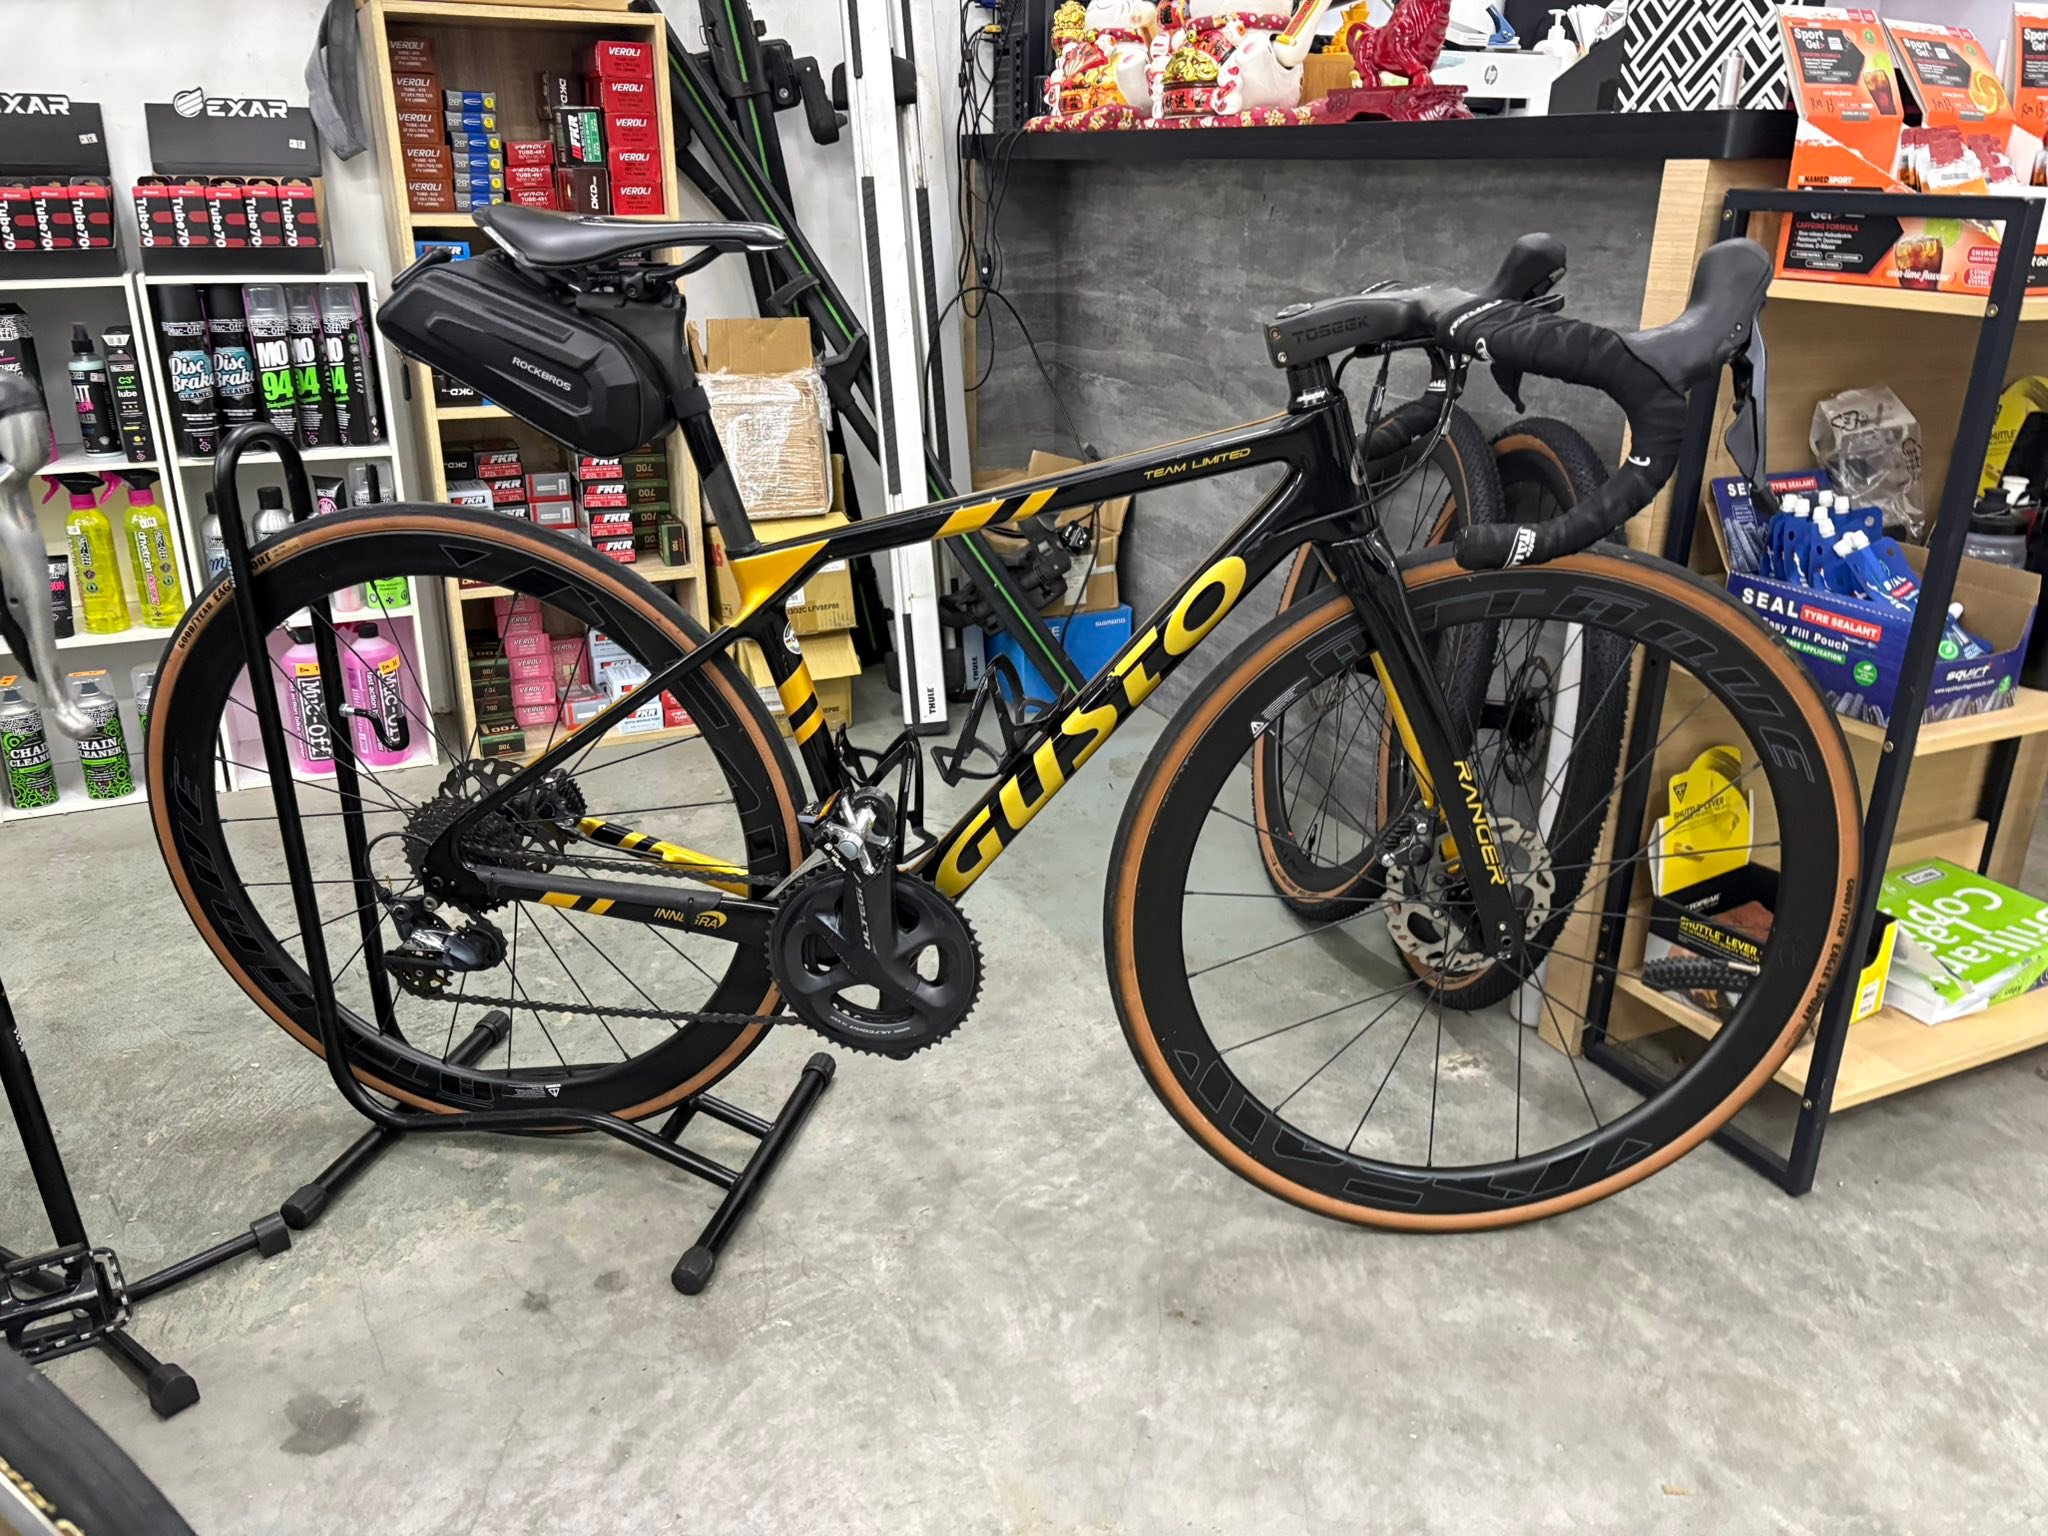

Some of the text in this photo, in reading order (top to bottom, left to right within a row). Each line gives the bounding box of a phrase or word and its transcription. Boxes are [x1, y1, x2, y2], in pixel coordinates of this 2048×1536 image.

[1794, 28, 1824, 40] Sport
[2024, 28, 2048, 43] Spor
[390, 41, 424, 50] VEROLI
[1805, 40, 1820, 49] Gel
[1903, 38, 1931, 50] Sport
[2032, 42, 2047, 51] Gel
[609, 47, 640, 56] VEROLI
[1916, 47, 1929, 57] Gel
[396, 77, 430, 87] VEROLI
[611, 83, 643, 92] VEROLI
[206, 100, 289, 118] EXAR
[398, 113, 432, 122] VEROLI
[615, 118, 647, 127] VEROLI
[568, 114, 581, 148] FKR
[407, 149, 440, 157] VEROLI
[619, 153, 649, 161] VEROLI
[409, 182, 442, 191] VEROLI
[620, 187, 651, 196] VEROLI
[1826, 224, 1859, 232] FORMULA
[1291, 315, 1372, 343] TOSEEK
[171, 357, 205, 376] Disc
[213, 353, 246, 371] Disc
[511, 356, 573, 392] ROCKBROS
[261, 369, 294, 401] 94
[490, 453, 518, 464] FKR
[1144, 447, 1251, 481] TEAM LIMITED
[494, 479, 521, 490] FKR
[596, 484, 625, 494] FKR
[1788, 480, 1814, 488] SEALANT
[461, 496, 484, 505] FKR
[602, 513, 631, 523] FKR
[605, 540, 633, 550] FKR
[1741, 587, 1799, 619] SEAL
[509, 615, 532, 623] EROLI
[1095, 618, 1126, 627] SHIMANO
[1803, 609, 1878, 637] TYRE SEALANT
[513, 638, 539, 646] VEROLI
[1791, 626, 1810, 640] Fill
[1813, 632, 1850, 652] Pouch
[553, 643, 576, 651] VEROLI
[1802, 642, 1843, 661] APPLICATION
[517, 658, 542, 667] VEROLI
[972, 656, 980, 682] THULE
[519, 685, 545, 693] VEROLI
[926, 687, 936, 715] THULE
[522, 706, 548, 714] VEROLI
[636, 708, 658, 717] FKR
[301, 680, 332, 758] Muc-Off
[935, 556, 1247, 898] GUSTO
[1453, 760, 1506, 885] RANGER
[1726, 935, 1758, 956] LEVER
[1802, 878, 1855, 1021] GOODYEAR EAGLE SPORT
